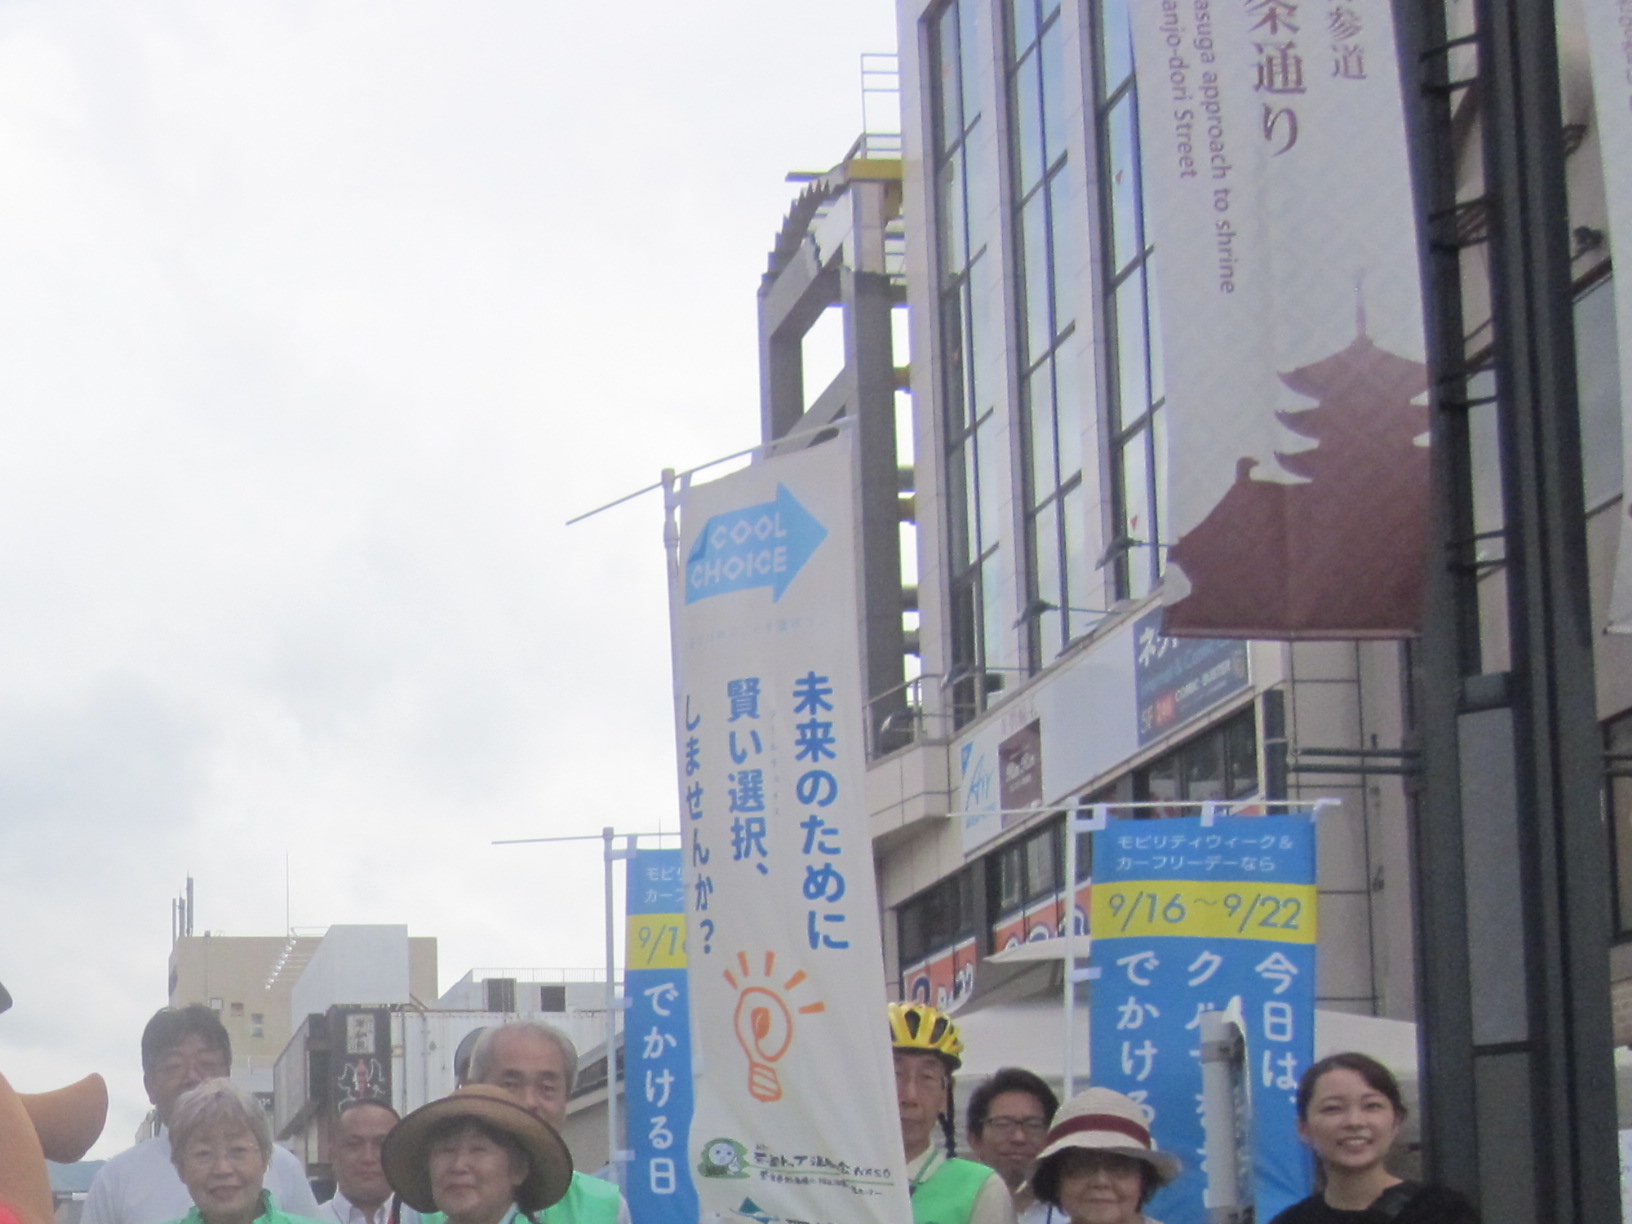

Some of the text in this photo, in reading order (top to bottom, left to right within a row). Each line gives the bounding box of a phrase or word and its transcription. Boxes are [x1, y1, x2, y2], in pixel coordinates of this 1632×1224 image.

[1174, 108, 1198, 179] Street
[1199, 70, 1232, 180] approach
[1213, 187, 1231, 213] to
[1216, 219, 1238, 295] shrine
[690, 544, 789, 588] CHOICE
[709, 509, 789, 552] COOL
[726, 676, 770, 876] 賢い選択、
[792, 670, 850, 950] 未来のために
[1116, 855, 1276, 872] カーフリーデーなら
[642, 981, 679, 1195] でかける日
